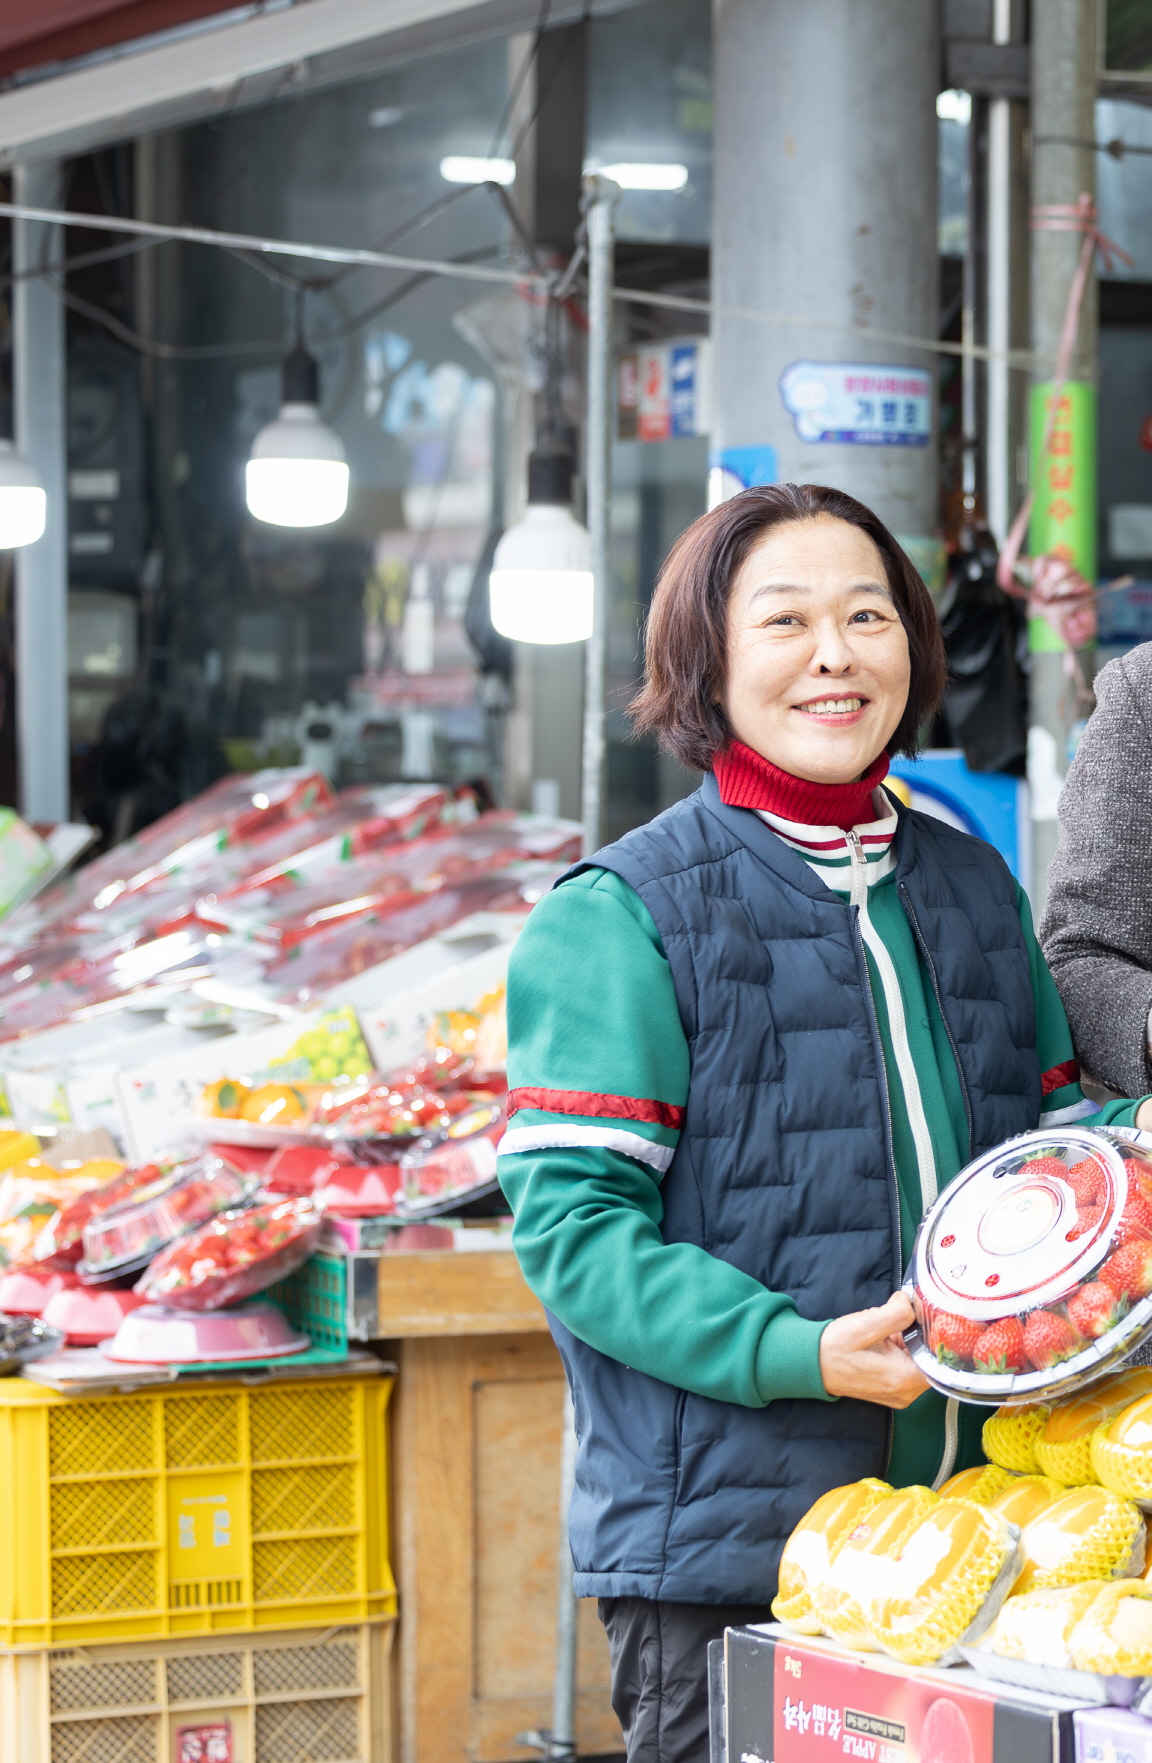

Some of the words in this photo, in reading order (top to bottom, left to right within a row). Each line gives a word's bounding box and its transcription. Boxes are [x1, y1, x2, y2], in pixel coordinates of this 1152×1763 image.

[784, 1655, 802, 1679] 5kg
[783, 1696, 842, 1741] 名品사과
[842, 1734, 877, 1760] APPLE
